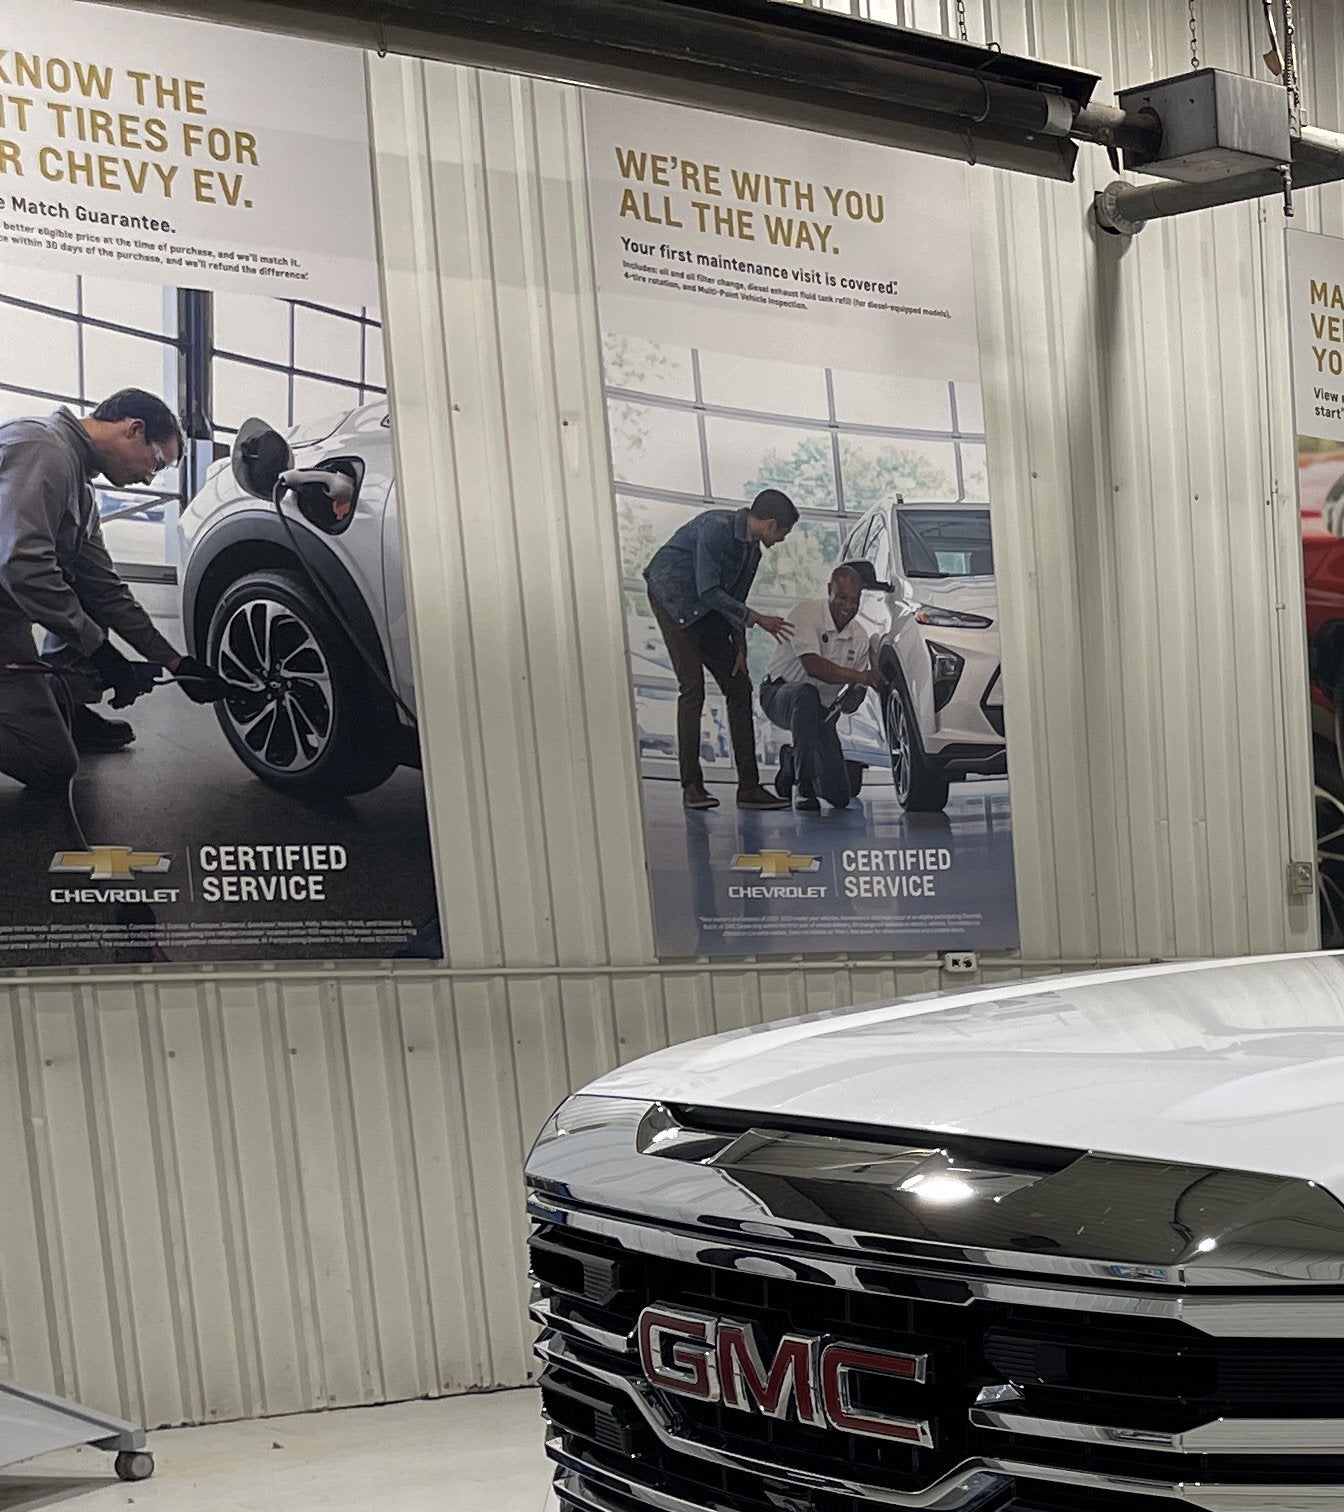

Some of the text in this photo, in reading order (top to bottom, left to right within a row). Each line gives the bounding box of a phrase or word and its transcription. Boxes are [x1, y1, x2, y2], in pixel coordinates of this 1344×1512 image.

[127, 70, 207, 115] THE
[47, 102, 169, 153] TIRES
[183, 123, 260, 166] FOR
[39, 146, 179, 198] CHEVY
[194, 169, 253, 208] EV.
[615, 147, 885, 224] WE'RE WITH YOU
[12, 196, 69, 219] Match
[75, 205, 176, 234] Guarantee.
[620, 188, 840, 255] ALL THE WAY.
[3, 221, 35, 234] better
[38, 227, 73, 240] eligible
[76, 233, 101, 244] price
[104, 237, 113, 245] at
[116, 238, 131, 247] the
[134, 240, 155, 251] time
[158, 243, 168, 251] of
[170, 245, 216, 259] purchase,
[218, 251, 234, 260] and
[260, 257, 288, 266] match
[11, 236, 42, 248] within
[46, 240, 58, 249] 30
[60, 242, 83, 255] days
[86, 246, 96, 255] of
[98, 248, 114, 257] the
[166, 257, 182, 266] and
[208, 261, 239, 273] refund
[242, 266, 256, 274] the
[621, 236, 656, 256] Your
[660, 244, 692, 264] first
[697, 254, 788, 280] maintenance
[792, 268, 822, 285] visit
[825, 273, 837, 287] is
[1314, 387, 1339, 403] View
[200, 844, 348, 872] CERTIFIED
[842, 848, 951, 872] CERTIFIED
[50, 888, 180, 903] CHEVROLET
[202, 875, 325, 902] SERVICE
[728, 886, 827, 898] CHEVROLET
[845, 875, 936, 898] SERVICE
[638, 1303, 934, 1449] GMC
